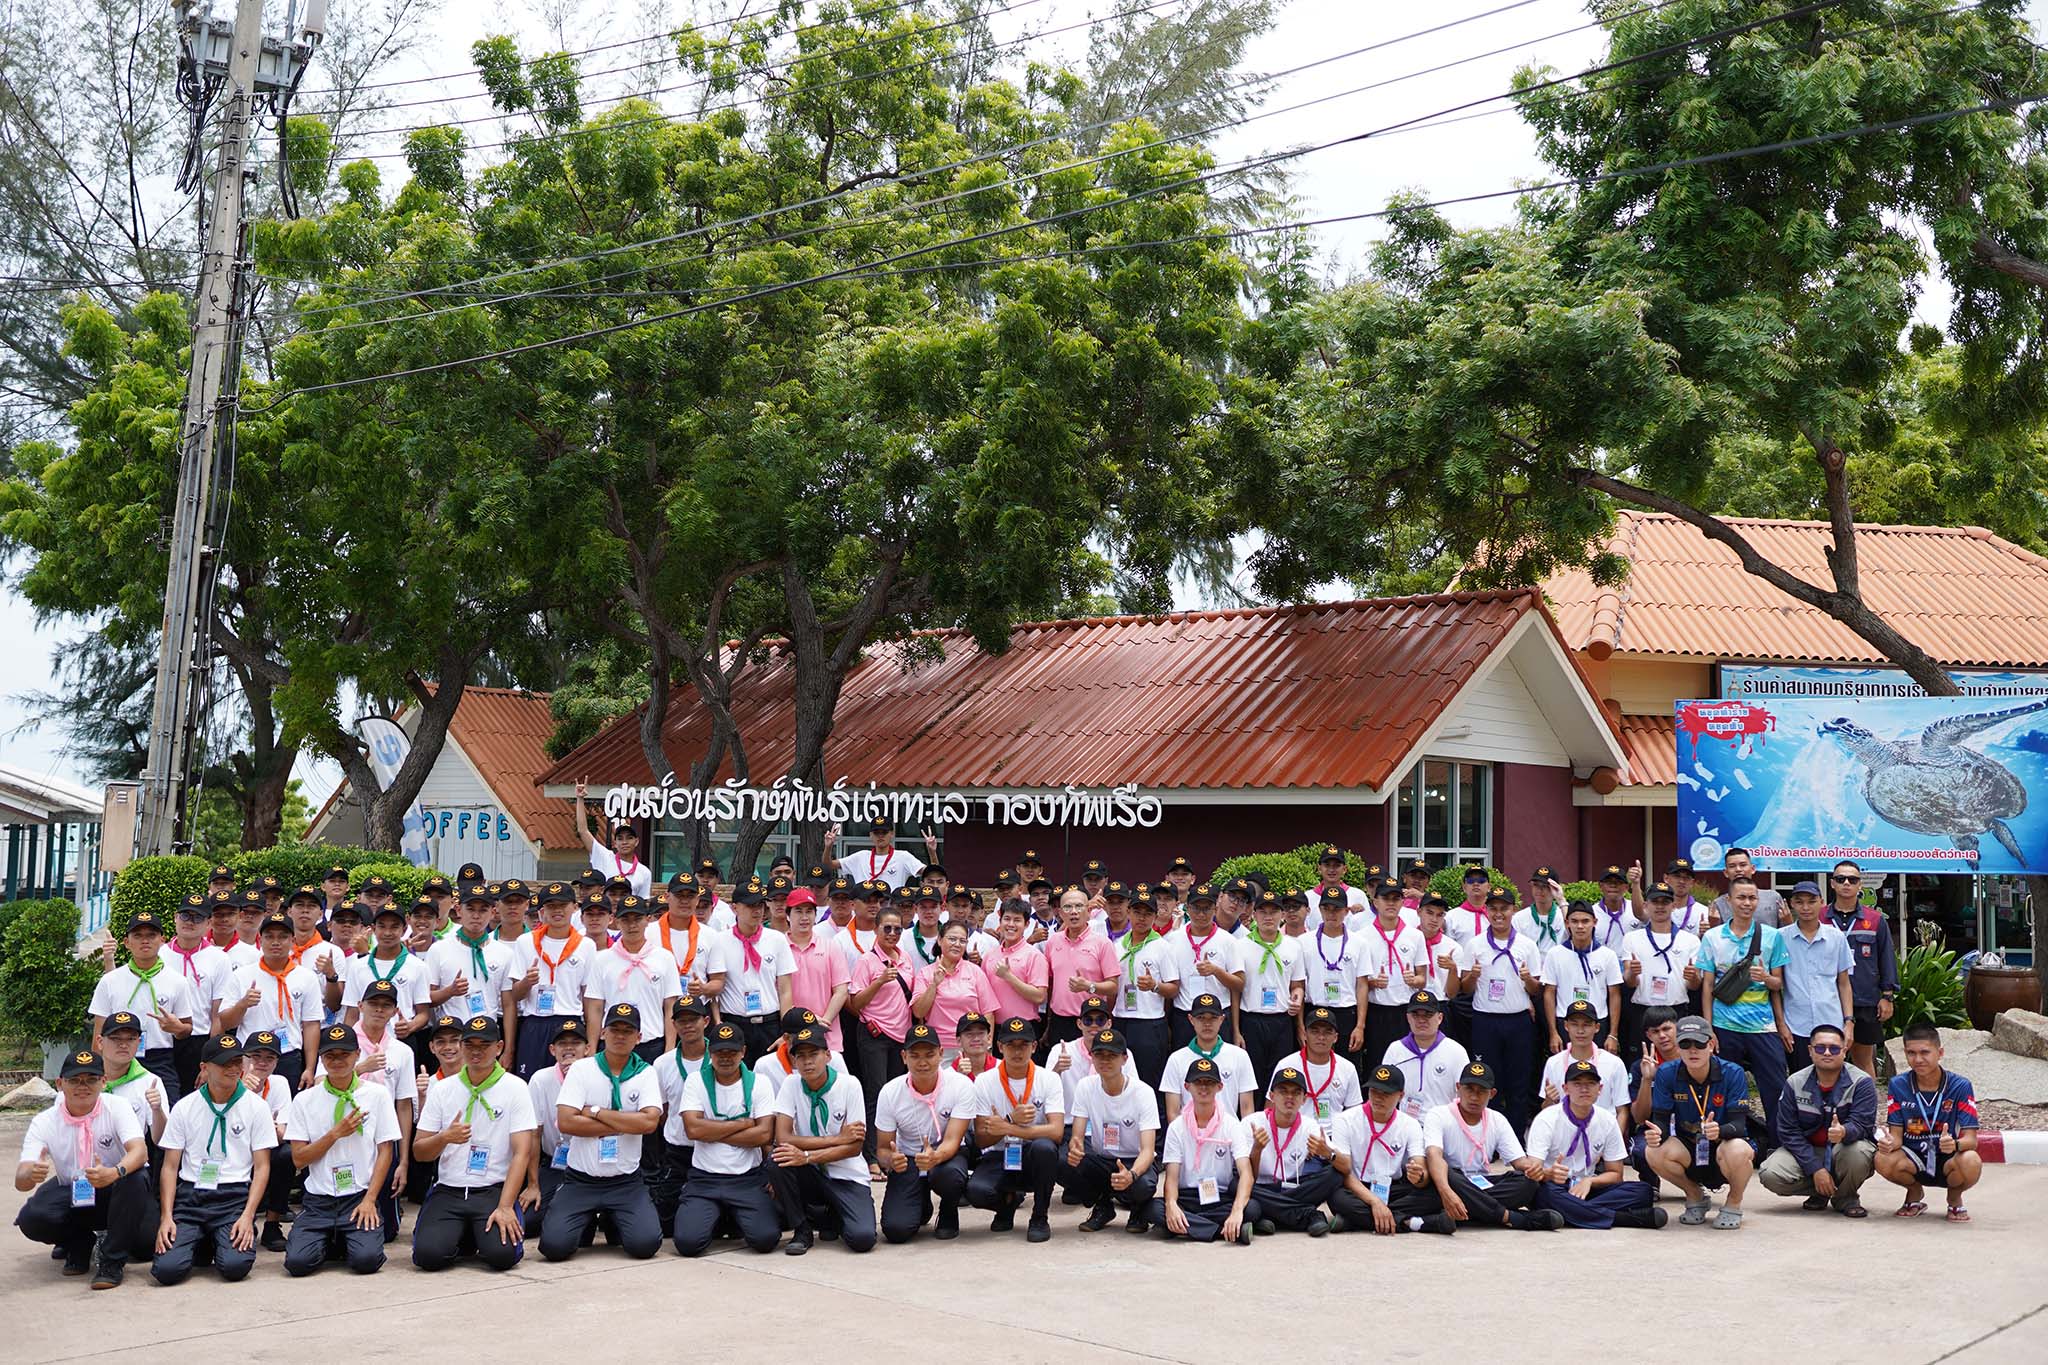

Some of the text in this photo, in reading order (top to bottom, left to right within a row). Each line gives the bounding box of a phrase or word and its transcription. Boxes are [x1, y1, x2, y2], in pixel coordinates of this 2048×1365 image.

[987, 783, 1162, 827] กองทัพเรือ
[424, 811, 511, 841] OFFEE
